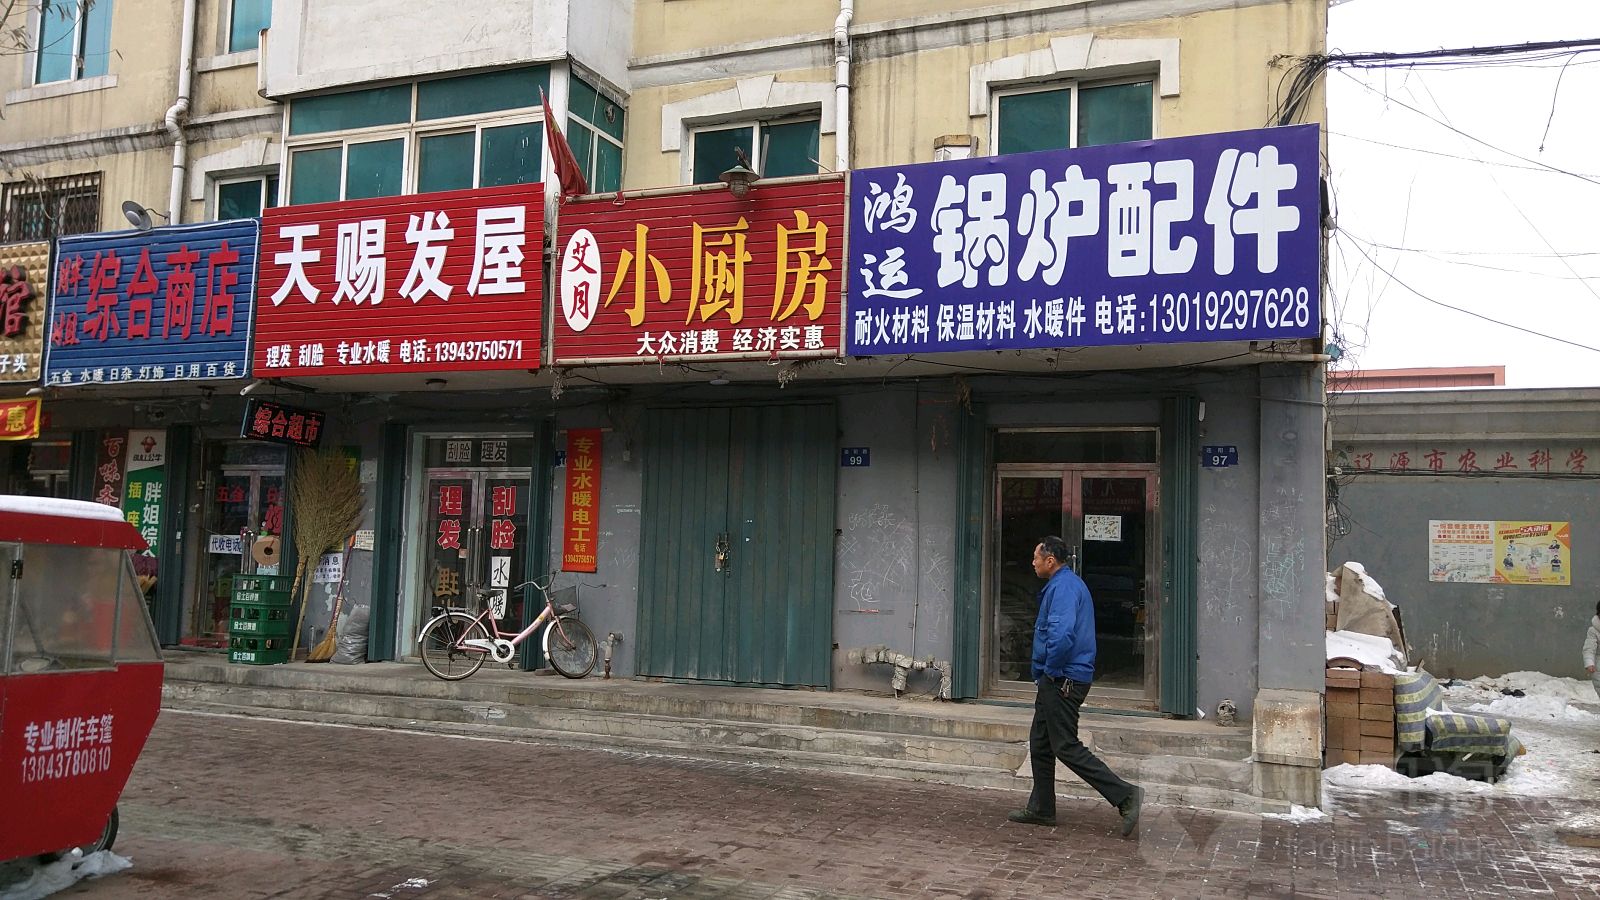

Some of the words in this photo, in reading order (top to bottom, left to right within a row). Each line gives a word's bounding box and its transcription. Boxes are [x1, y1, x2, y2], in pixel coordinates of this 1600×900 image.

[859, 172, 924, 300] 鸿运
[931, 145, 1301, 289] 锅炉配件
[270, 205, 527, 307] 天赐发屋
[604, 210, 833, 327] 小厨房
[51, 254, 85, 347] 胖姐
[83, 240, 240, 342] 综合商店
[636, 329, 720, 355] 大众消费
[732, 324, 825, 351] 经济实惠
[854, 304, 930, 346] 耐火材料
[936, 301, 1017, 342] 保温材料
[1023, 296, 1087, 339] 水暖件
[265, 345, 292, 368] 理发
[298, 342, 324, 367] 刮脸
[336, 339, 391, 365] 专业水暖
[51, 370, 73, 384] 五金
[80, 368, 104, 382] 水暖
[110, 366, 133, 380] 日杂
[139, 364, 164, 379] 灯饰
[252, 406, 322, 443] 综合超市
[446, 441, 471, 462] 刮脸
[481, 441, 507, 462] 理发
[849, 455, 862, 465] 99
[1212, 455, 1228, 465] 97
[1353, 449, 1588, 474] 辽源市农业科学
[215, 485, 245, 502] 五金
[569, 437, 595, 542] 专业水暖电工
[437, 486, 463, 550] 理发
[490, 486, 516, 550] 刮脸
[573, 543, 587, 553] 电话
[23, 713, 114, 753] 专业制作车篷
[22, 745, 112, 783] 13843780810
